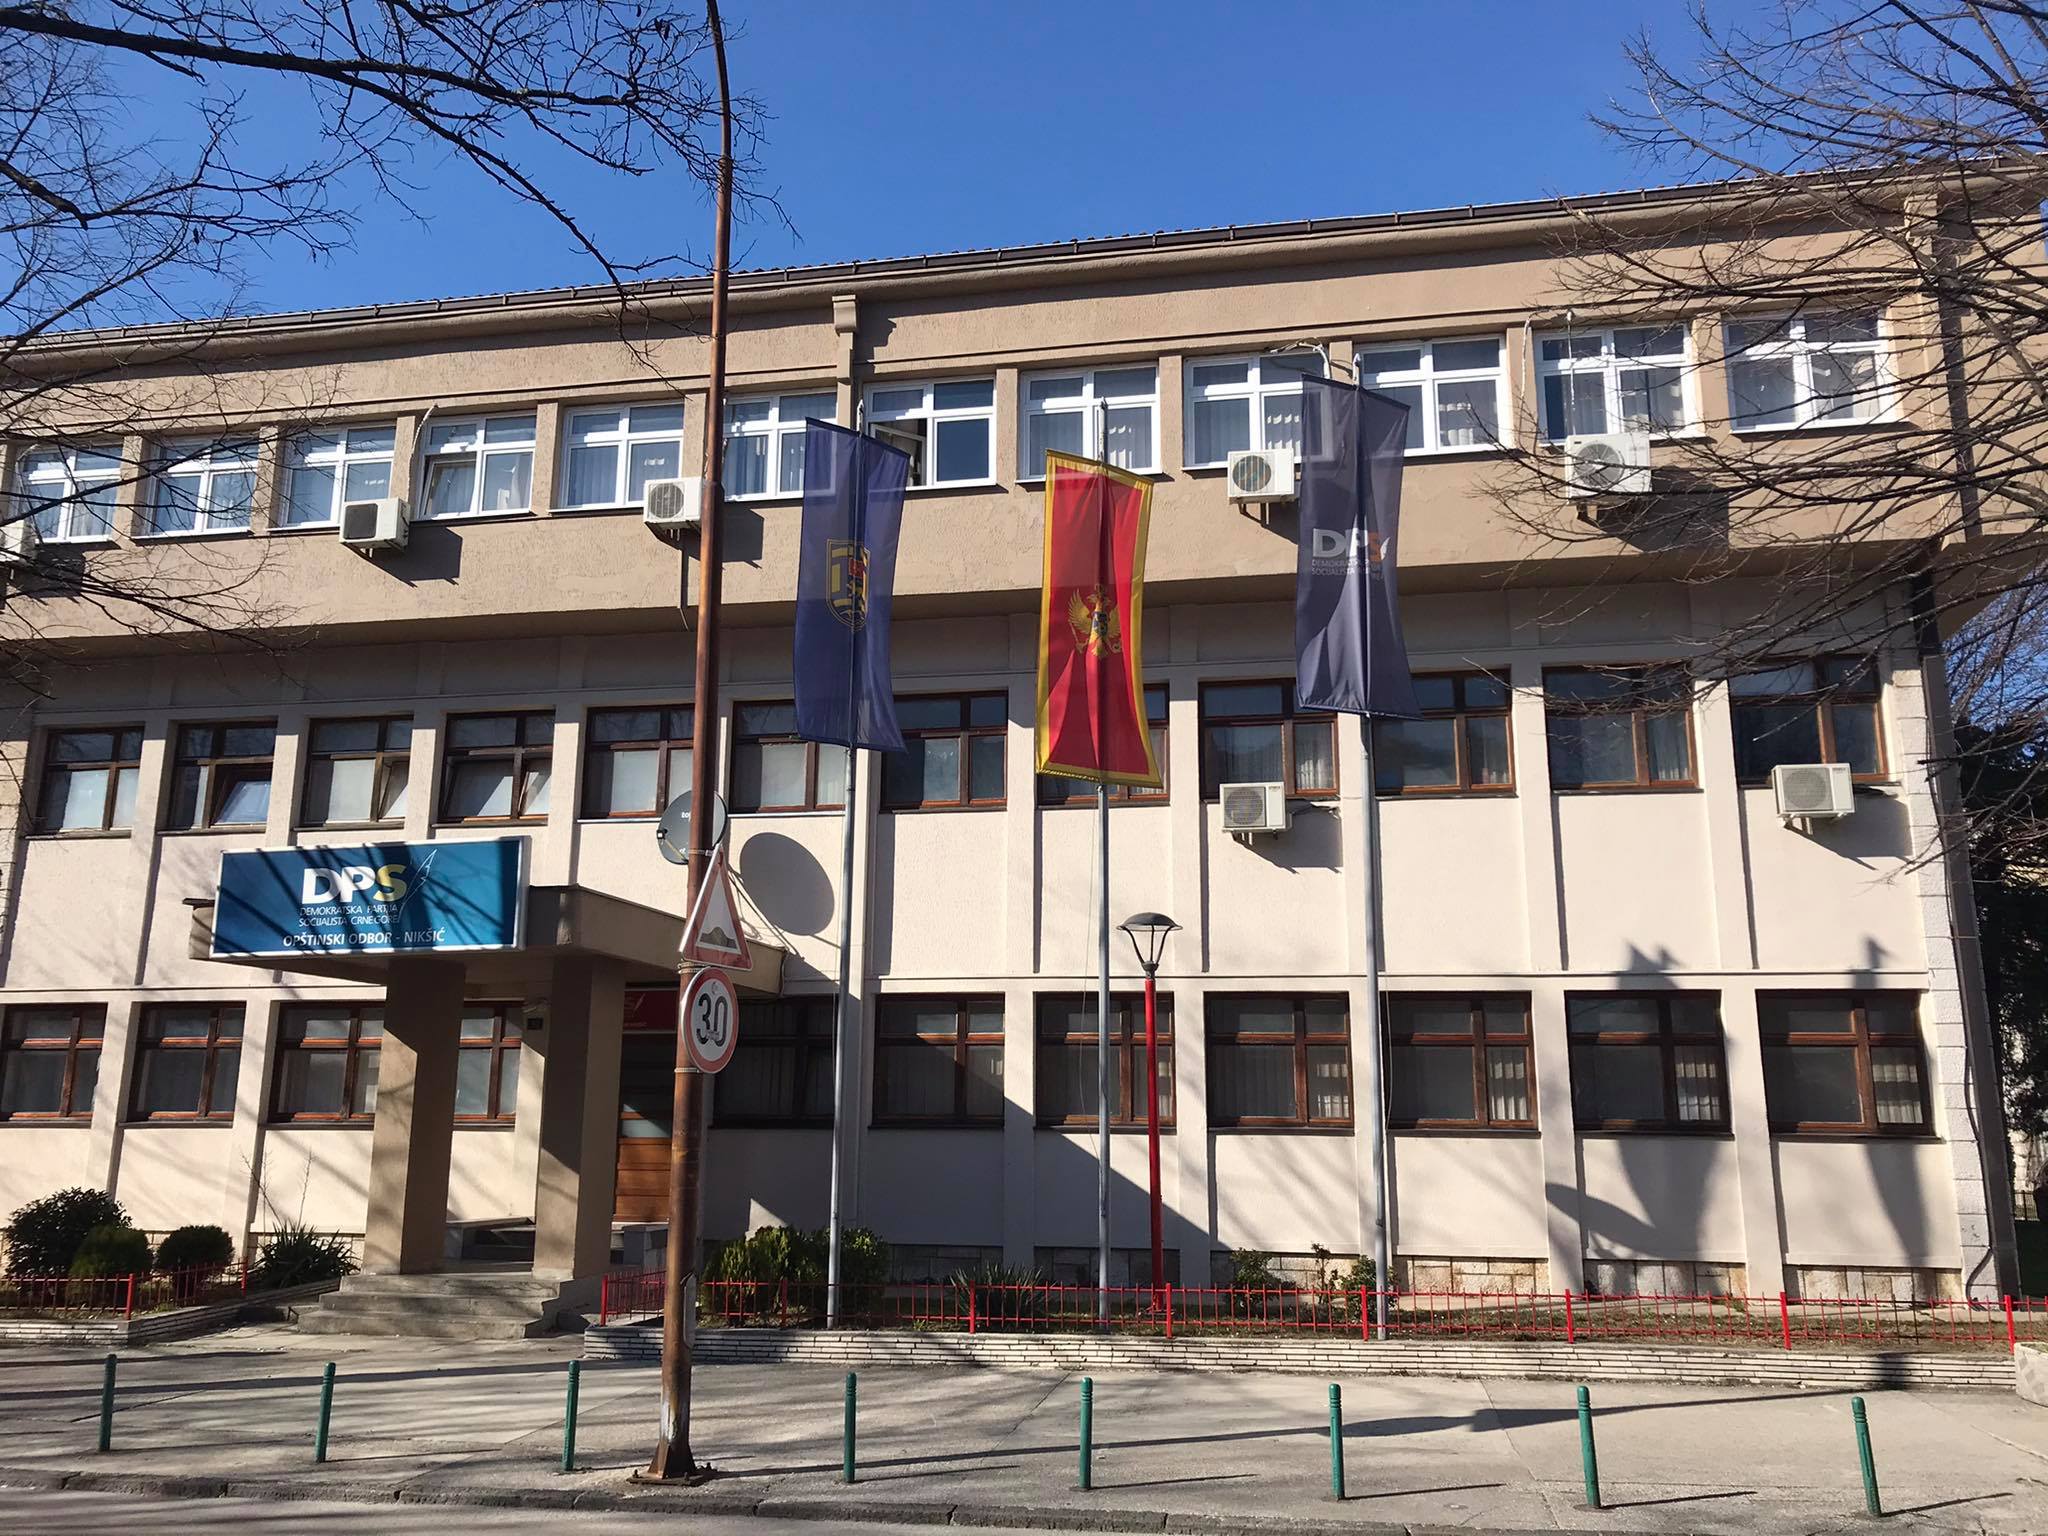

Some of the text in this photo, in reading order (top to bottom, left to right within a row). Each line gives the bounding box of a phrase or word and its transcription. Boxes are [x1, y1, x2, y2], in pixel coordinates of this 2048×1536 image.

[302, 864, 408, 905] DPS
[300, 905, 362, 916] DEMOKRATSKA
[299, 916, 348, 928] SOCIJALISTA
[283, 932, 345, 947] OPŠTINSKI
[348, 932, 392, 945] ODBOR
[404, 927, 446, 943] NIKŠIĆ
[696, 993, 728, 1047] 30
